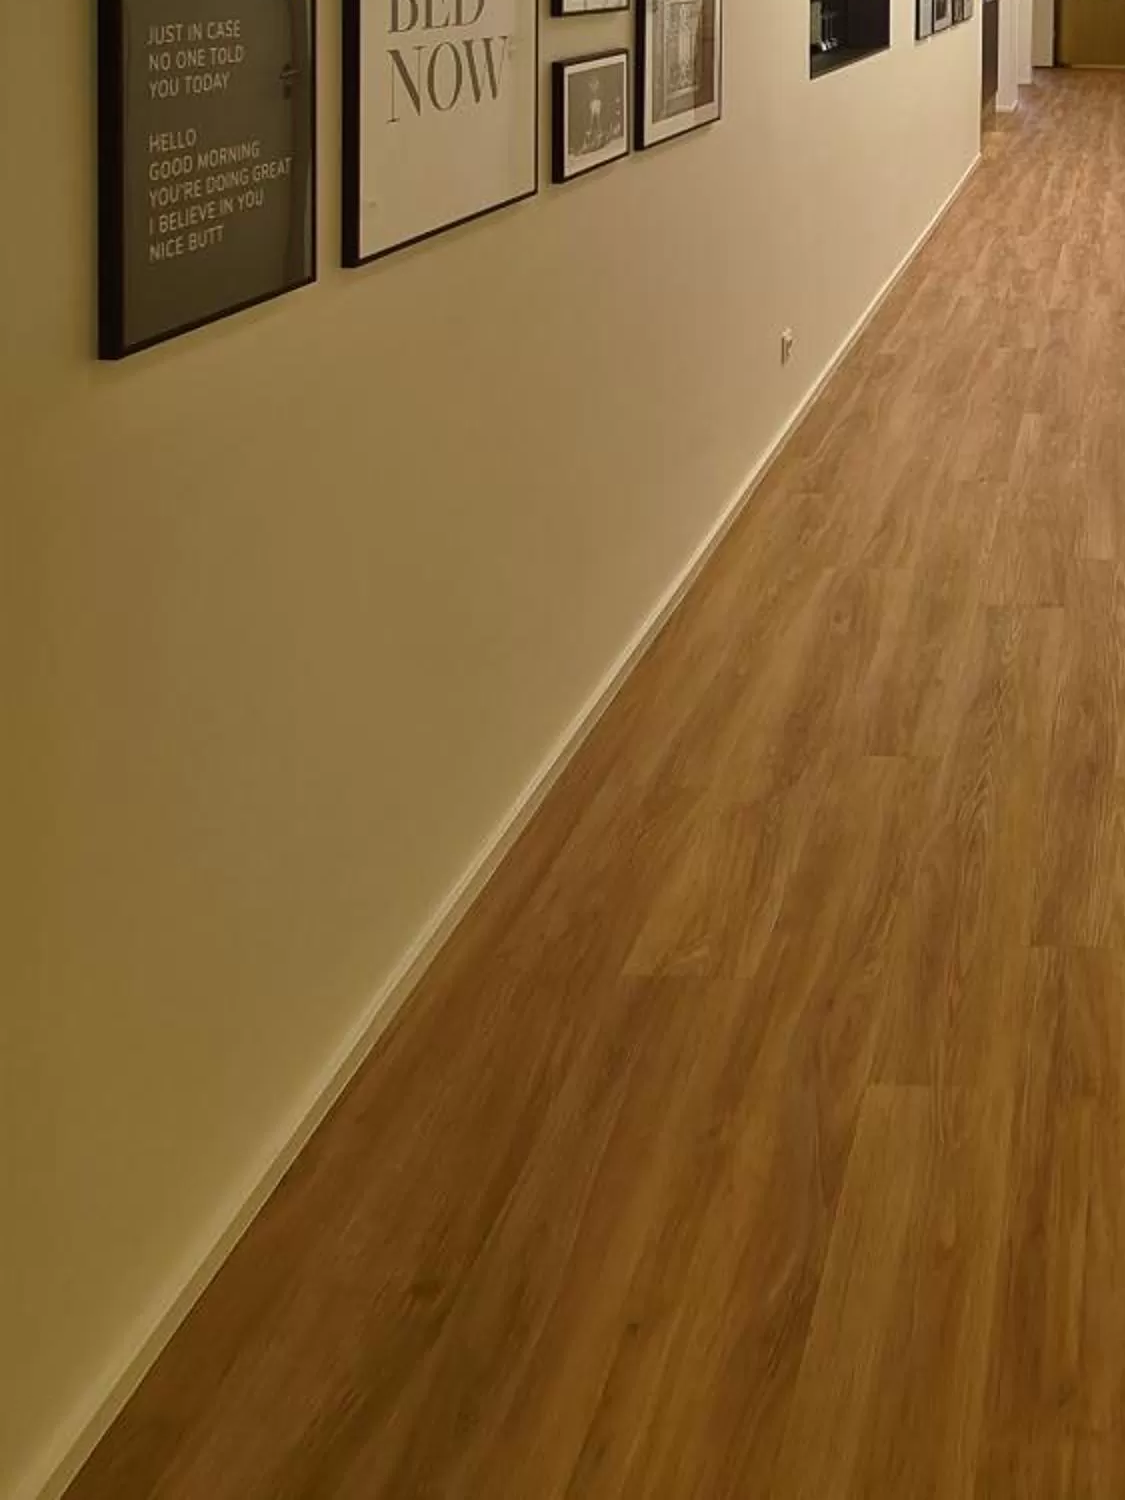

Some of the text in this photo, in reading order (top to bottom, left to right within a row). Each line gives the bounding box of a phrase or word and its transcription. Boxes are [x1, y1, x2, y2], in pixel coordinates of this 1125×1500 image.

[147, 19, 241, 45] JUST IN CASE
[149, 44, 245, 72] NO ONE TOLD
[149, 71, 231, 100] YOU TODAY
[386, 35, 508, 124] NOW
[149, 128, 197, 153] HELLO
[149, 139, 261, 181] GOOD MORNING
[149, 156, 293, 208] YOU'RE DOING GREAT
[159, 200, 217, 234] BELIEVE
[219, 196, 234, 216] IN
[237, 188, 265, 213] YOU
[149, 224, 225, 262] NICE BUTT
